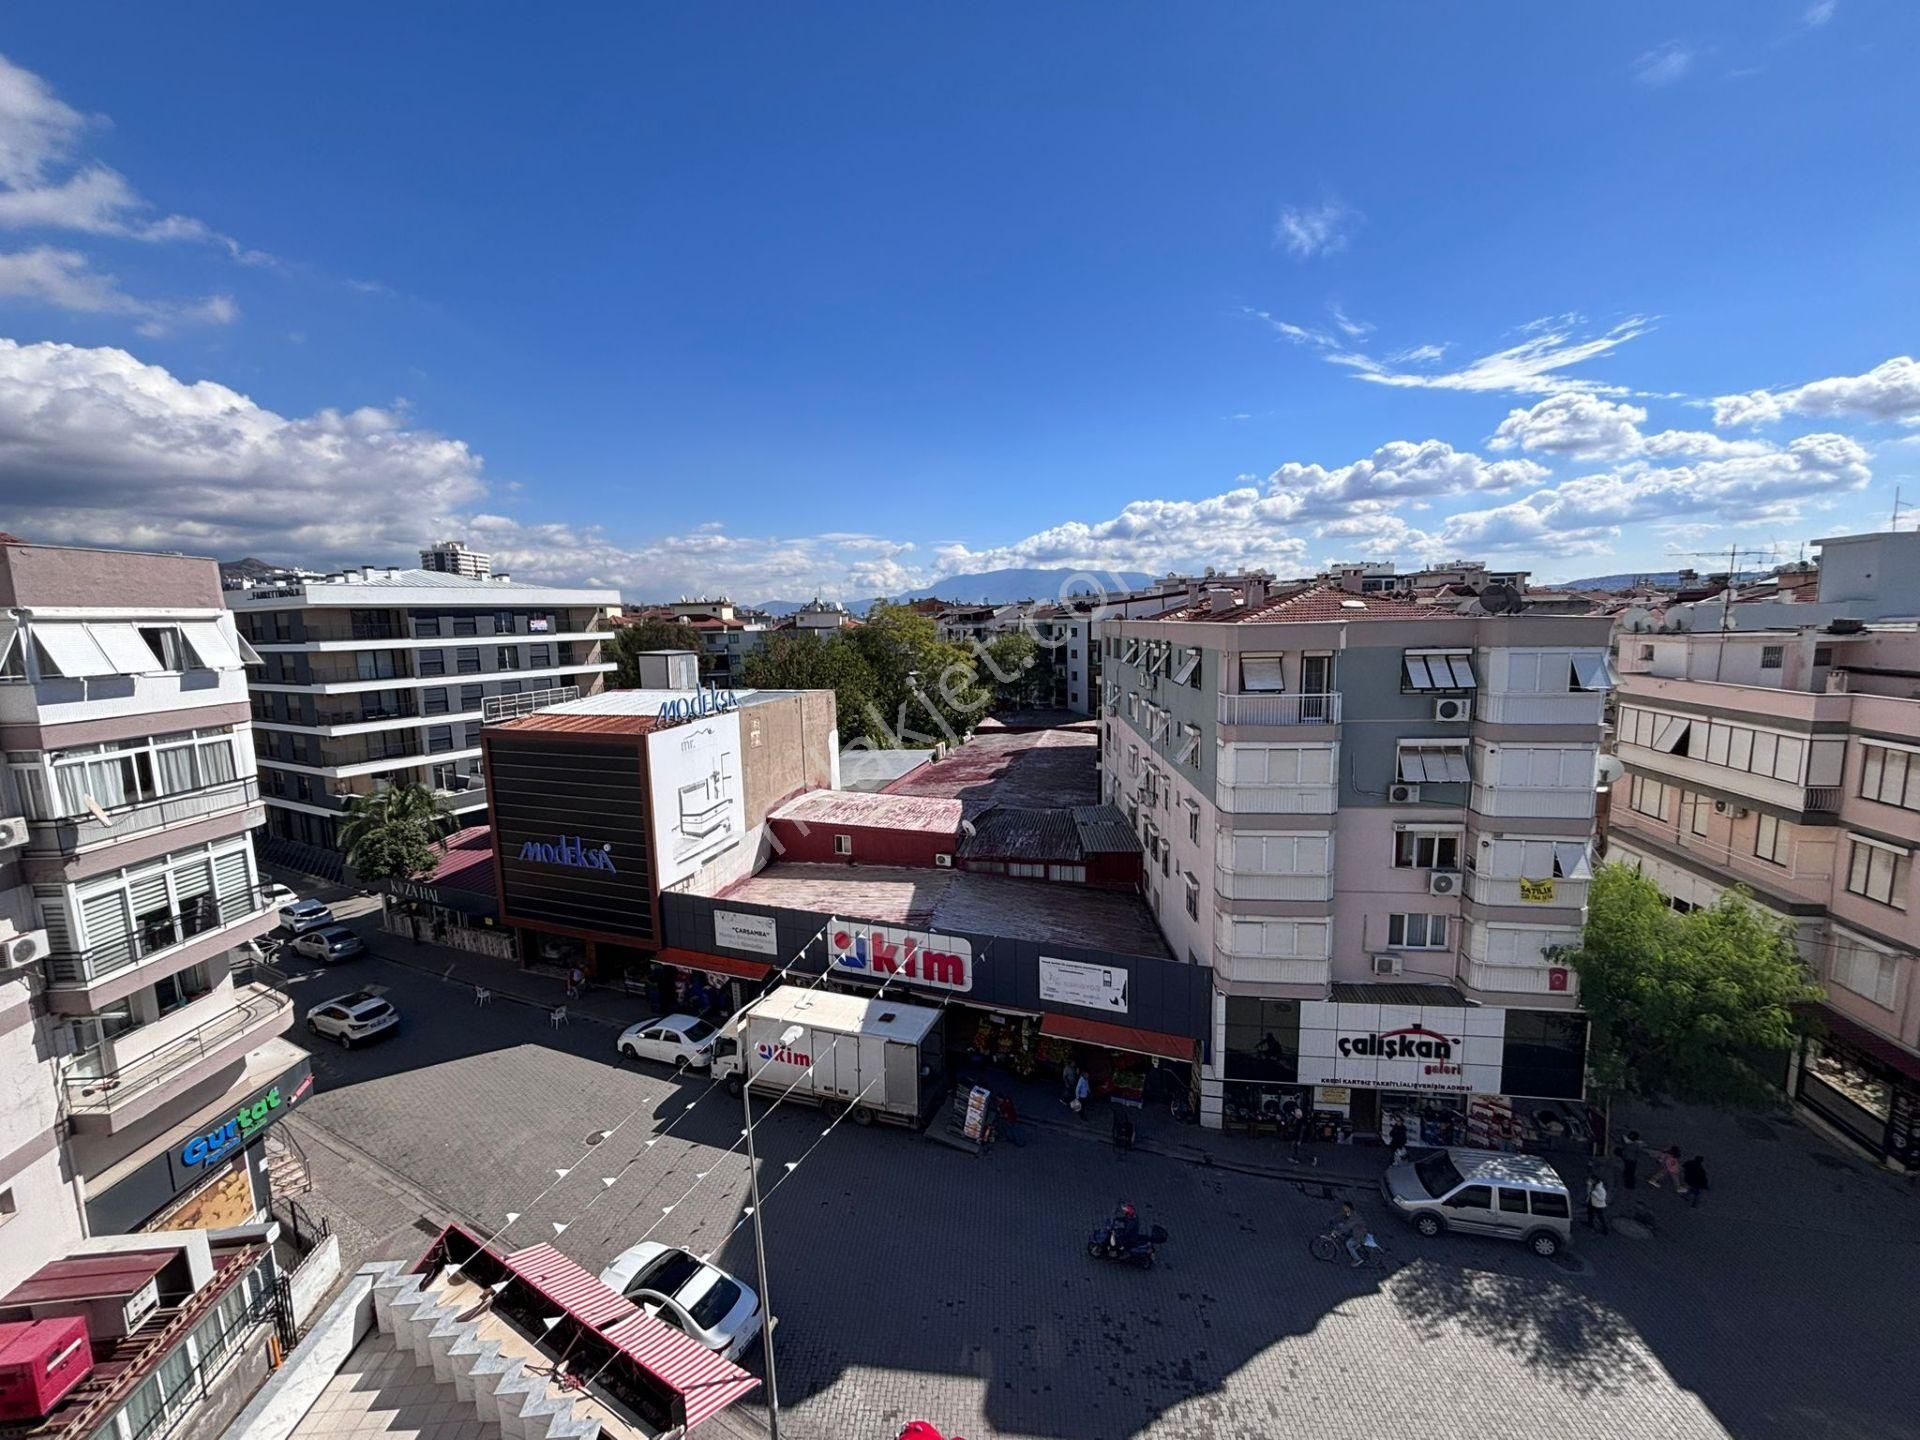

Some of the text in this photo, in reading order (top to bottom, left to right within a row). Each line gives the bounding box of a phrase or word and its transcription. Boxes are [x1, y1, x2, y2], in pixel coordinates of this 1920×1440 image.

[871, 932, 965, 986] kim
[773, 1047, 811, 1067] kim
[1338, 1034, 1451, 1059] çalışkan
[1424, 1063, 1462, 1075] galeri
